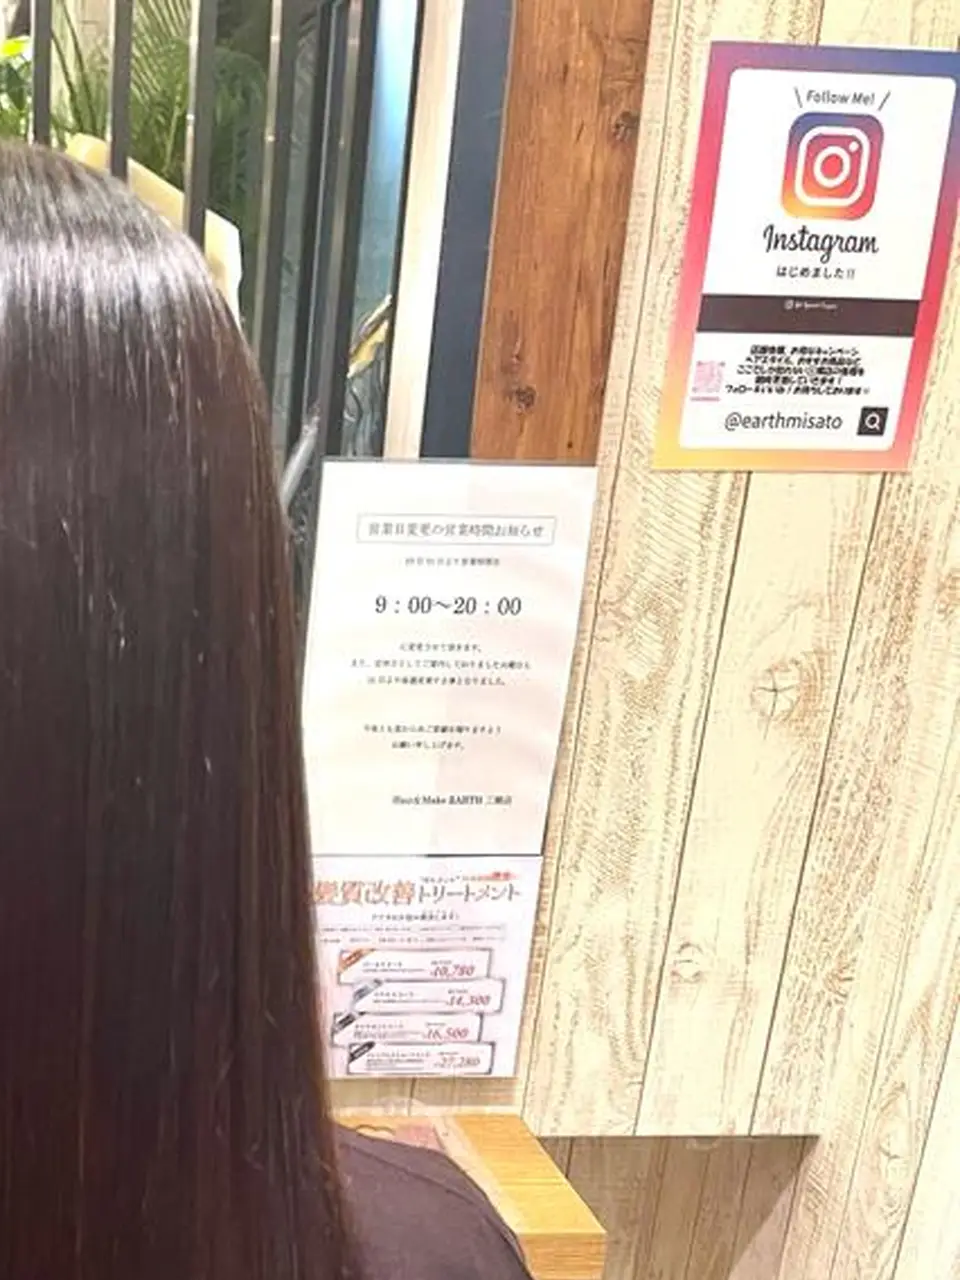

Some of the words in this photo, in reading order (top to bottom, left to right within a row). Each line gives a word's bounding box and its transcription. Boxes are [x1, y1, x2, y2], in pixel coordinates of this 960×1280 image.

[806, 90, 848, 104] Follow
[852, 92, 875, 105] Me!
[763, 224, 879, 264] Instagram
[724, 411, 844, 432] @earthmisato
[448, 795, 484, 806] EARTH
